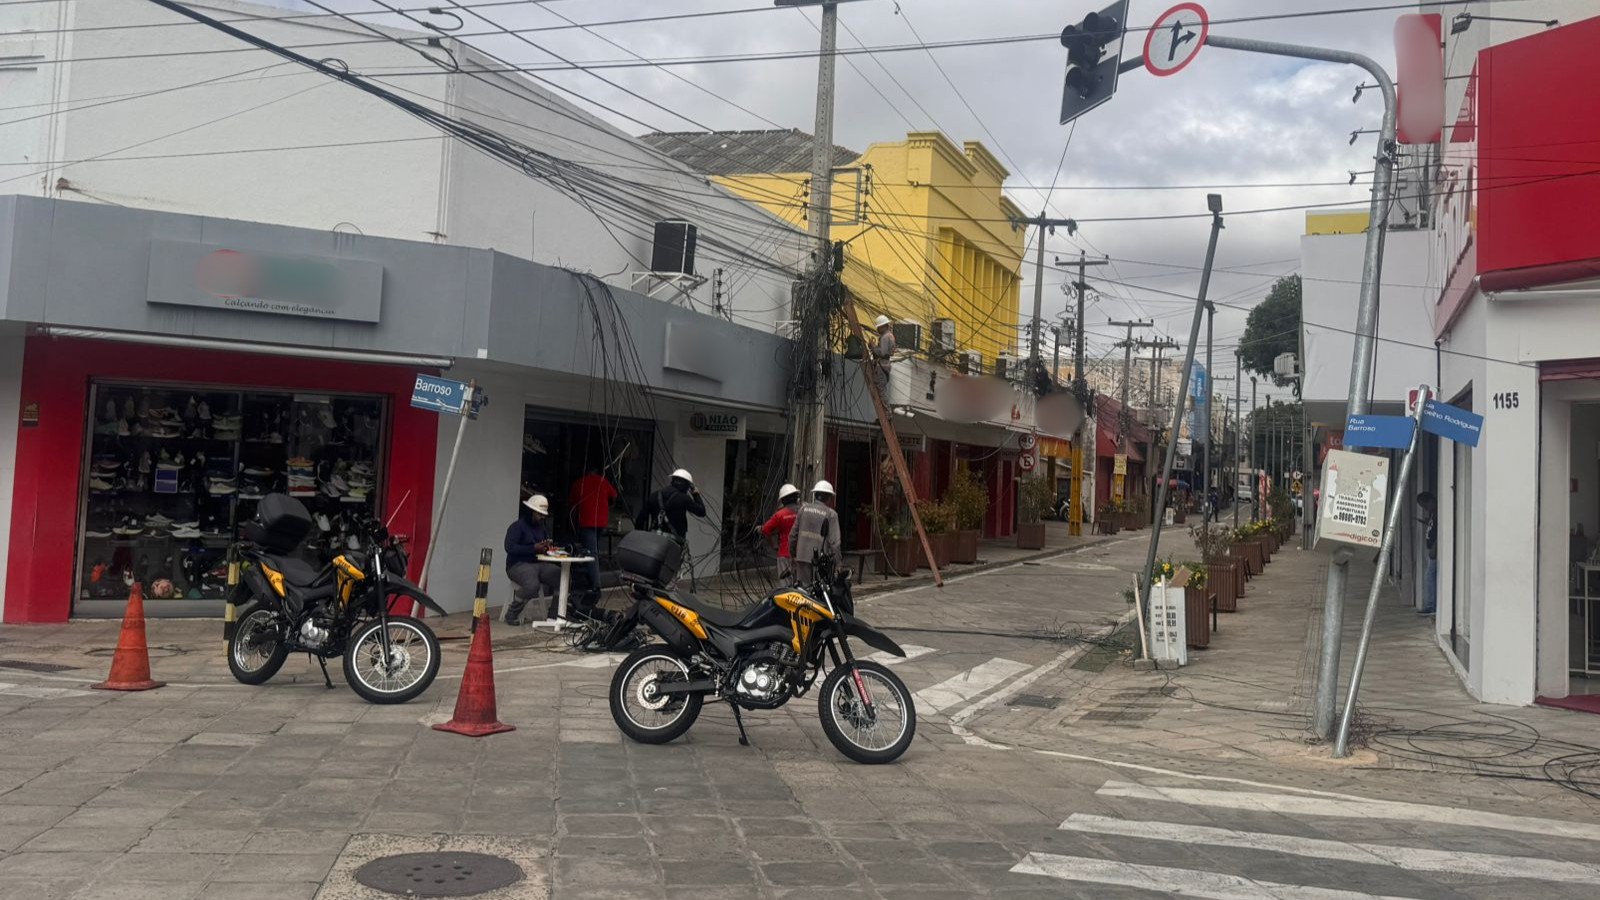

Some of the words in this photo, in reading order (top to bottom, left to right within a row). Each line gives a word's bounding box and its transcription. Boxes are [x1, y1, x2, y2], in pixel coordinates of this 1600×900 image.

[225, 298, 268, 309] Calçando
[271, 303, 289, 311] com
[415, 378, 452, 396] Barroso
[1493, 391, 1519, 409] 1155
[1424, 409, 1443, 420] oelho
[1444, 415, 1479, 432] Rodrigues
